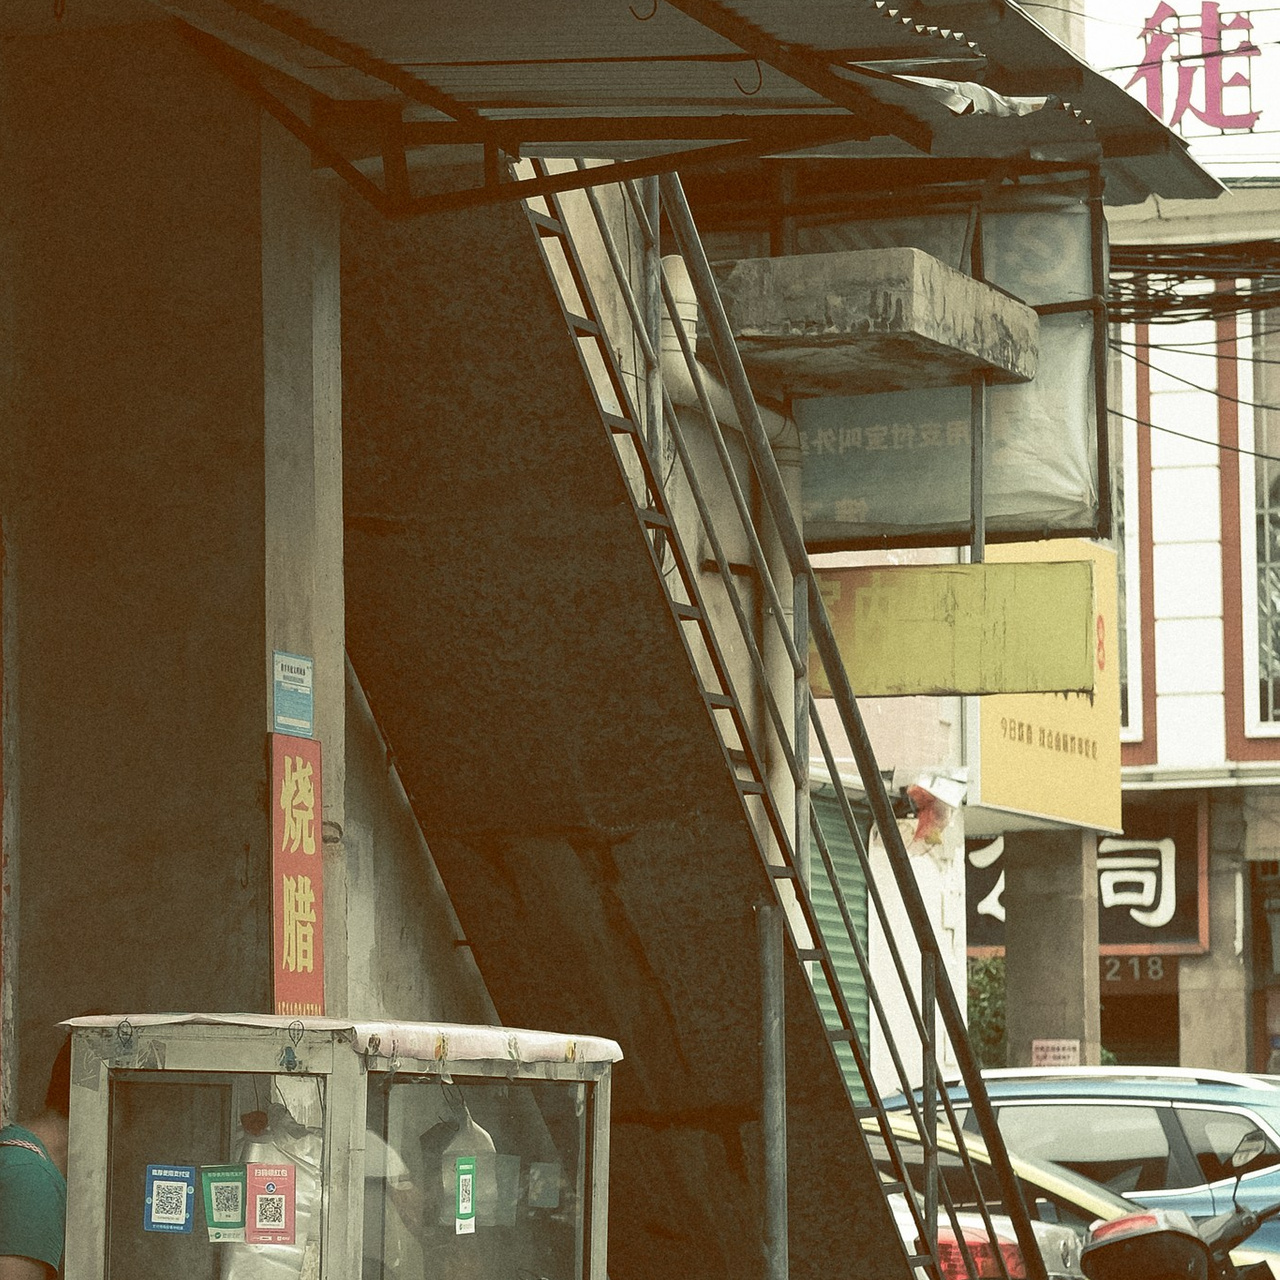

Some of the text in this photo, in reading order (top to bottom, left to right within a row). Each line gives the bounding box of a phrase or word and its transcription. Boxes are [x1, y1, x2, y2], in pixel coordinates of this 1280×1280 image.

[1124, 0, 1263, 131] 徒
[280, 755, 317, 974] 烧腊
[1105, 955, 1164, 982] 218
